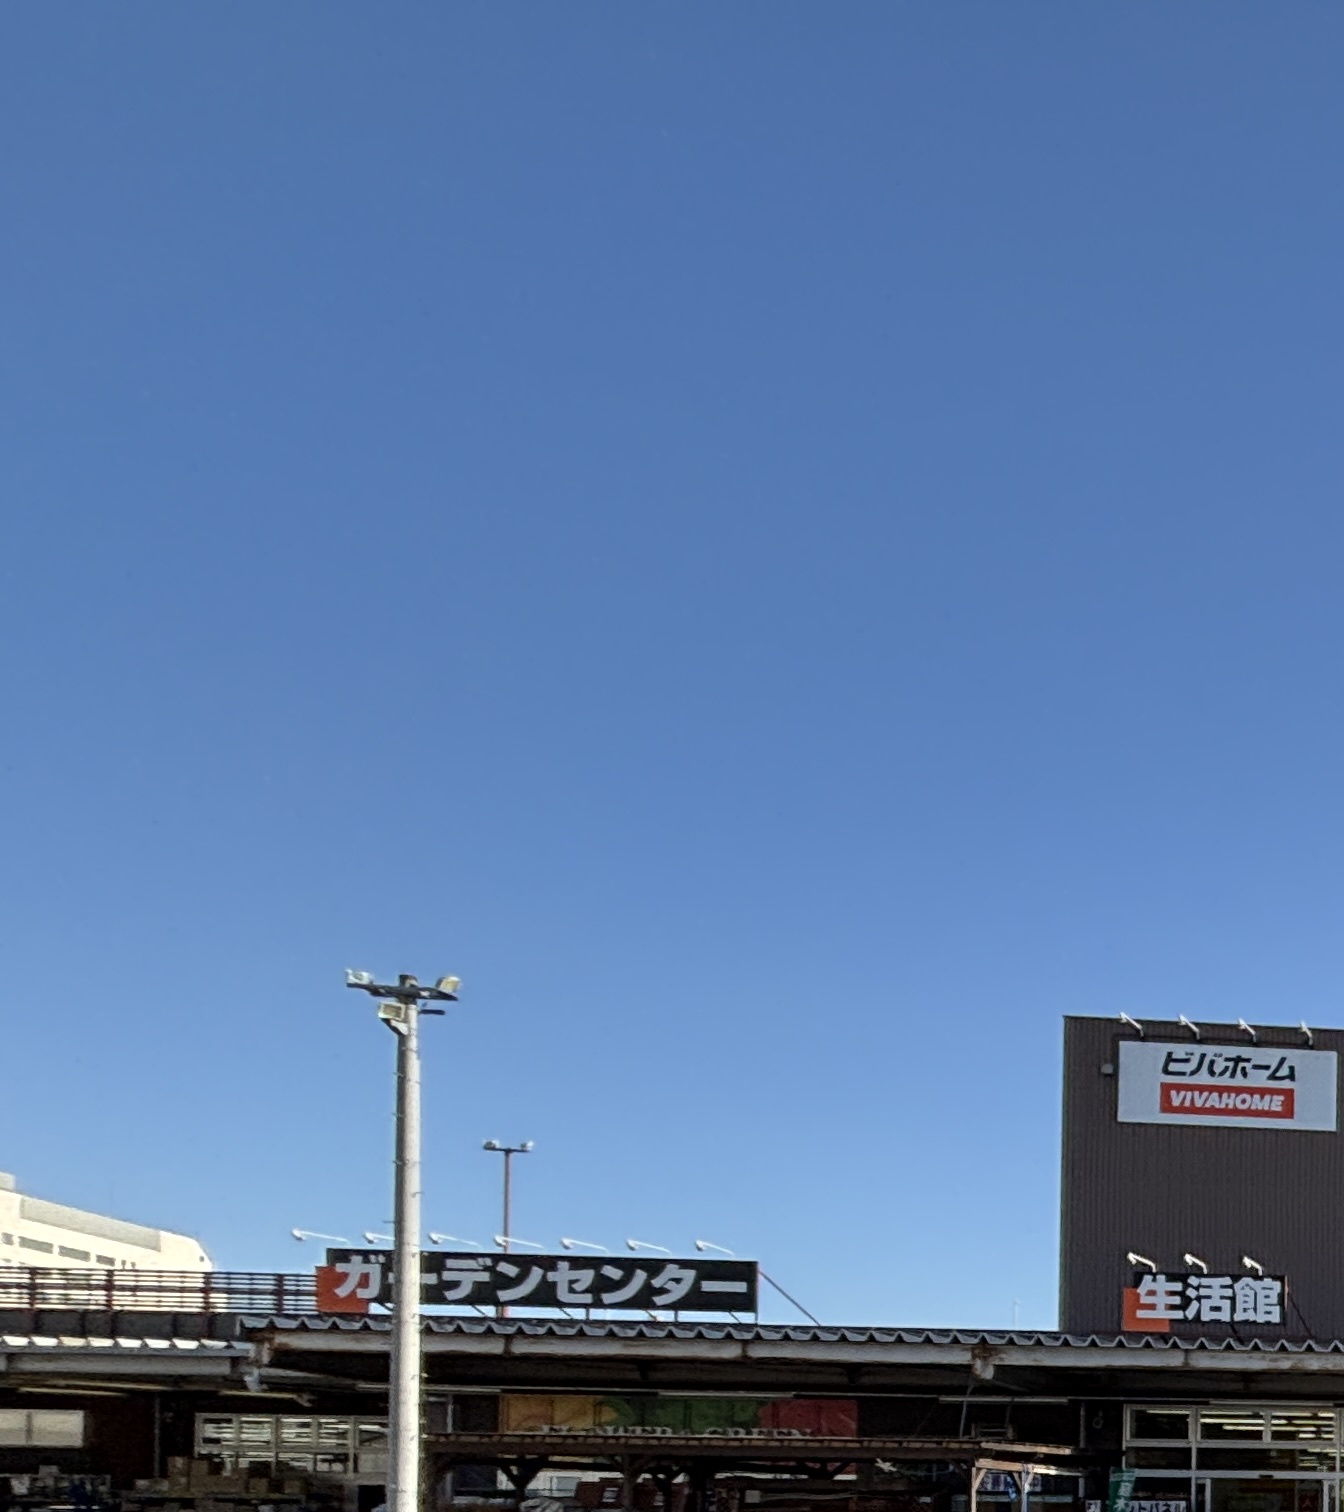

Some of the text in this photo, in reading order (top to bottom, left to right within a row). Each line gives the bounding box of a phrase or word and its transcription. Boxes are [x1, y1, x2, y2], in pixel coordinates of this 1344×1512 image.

[1161, 1050, 1296, 1083] ビバホーム
[1168, 1089, 1285, 1113] VIVAHOME
[1135, 1275, 1282, 1324] 生活館
